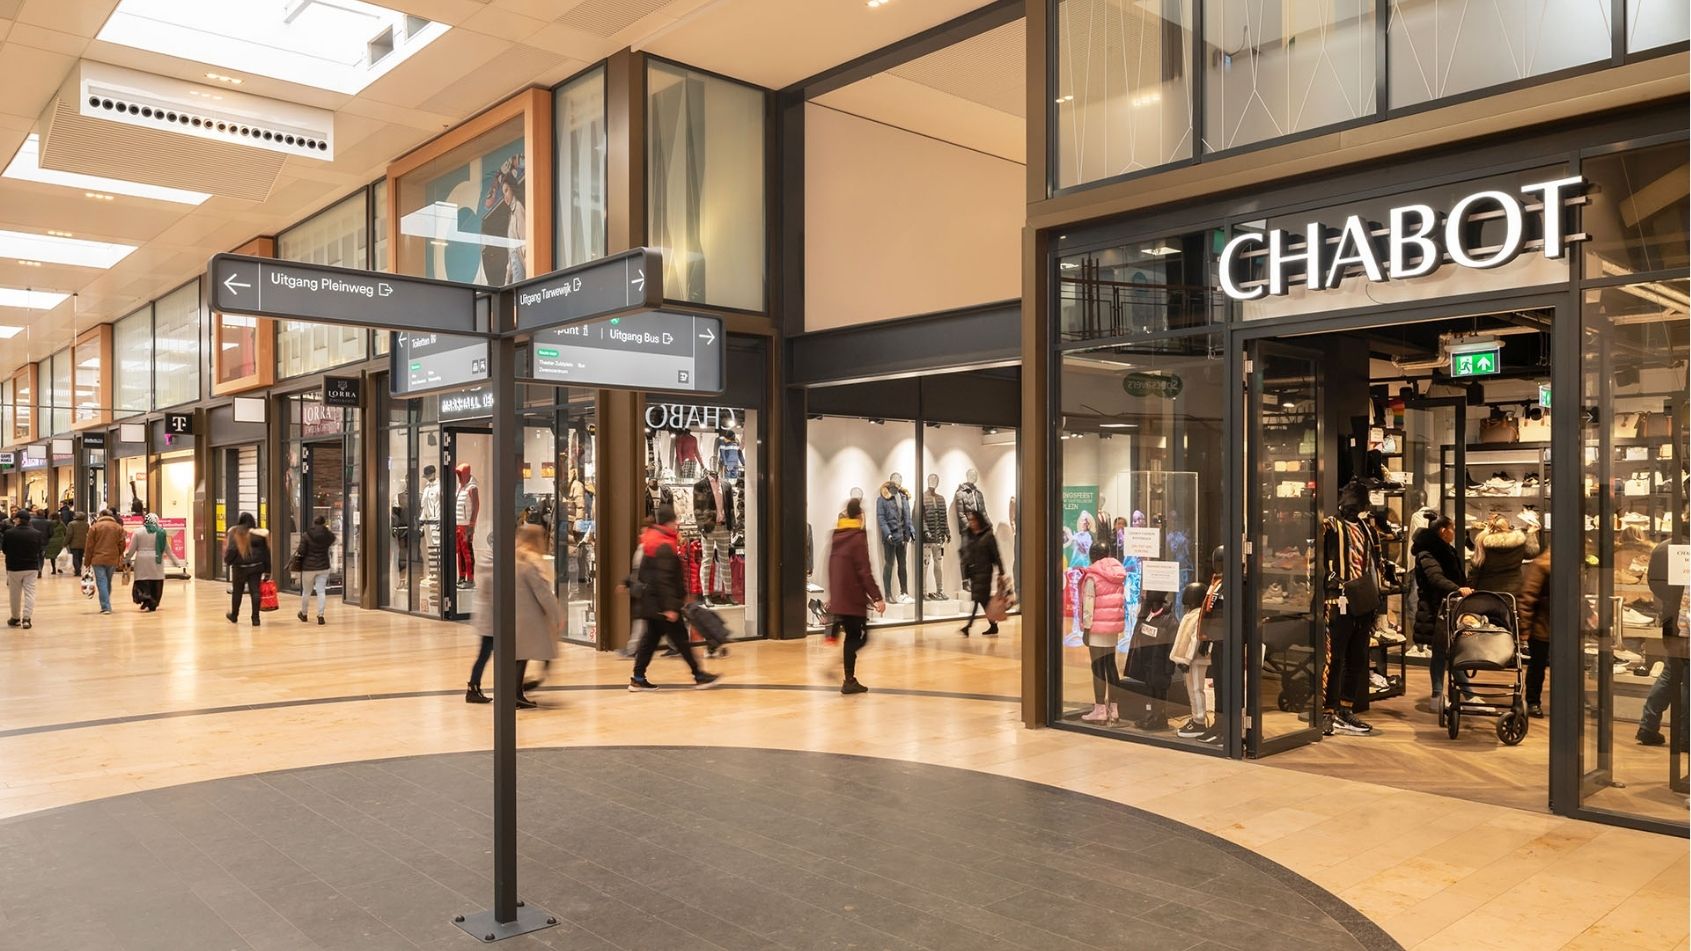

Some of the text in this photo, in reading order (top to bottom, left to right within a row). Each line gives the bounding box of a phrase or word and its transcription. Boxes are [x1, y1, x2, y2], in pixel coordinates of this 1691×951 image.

[1219, 175, 1582, 300] CHABOT
[271, 272, 374, 297] Uitgang Pleinweg
[520, 282, 571, 306] Uitgang Tarwewijk
[609, 329, 659, 344] Uitgang Bus
[328, 390, 357, 398] LORRA
[303, 405, 331, 425] LORRA
